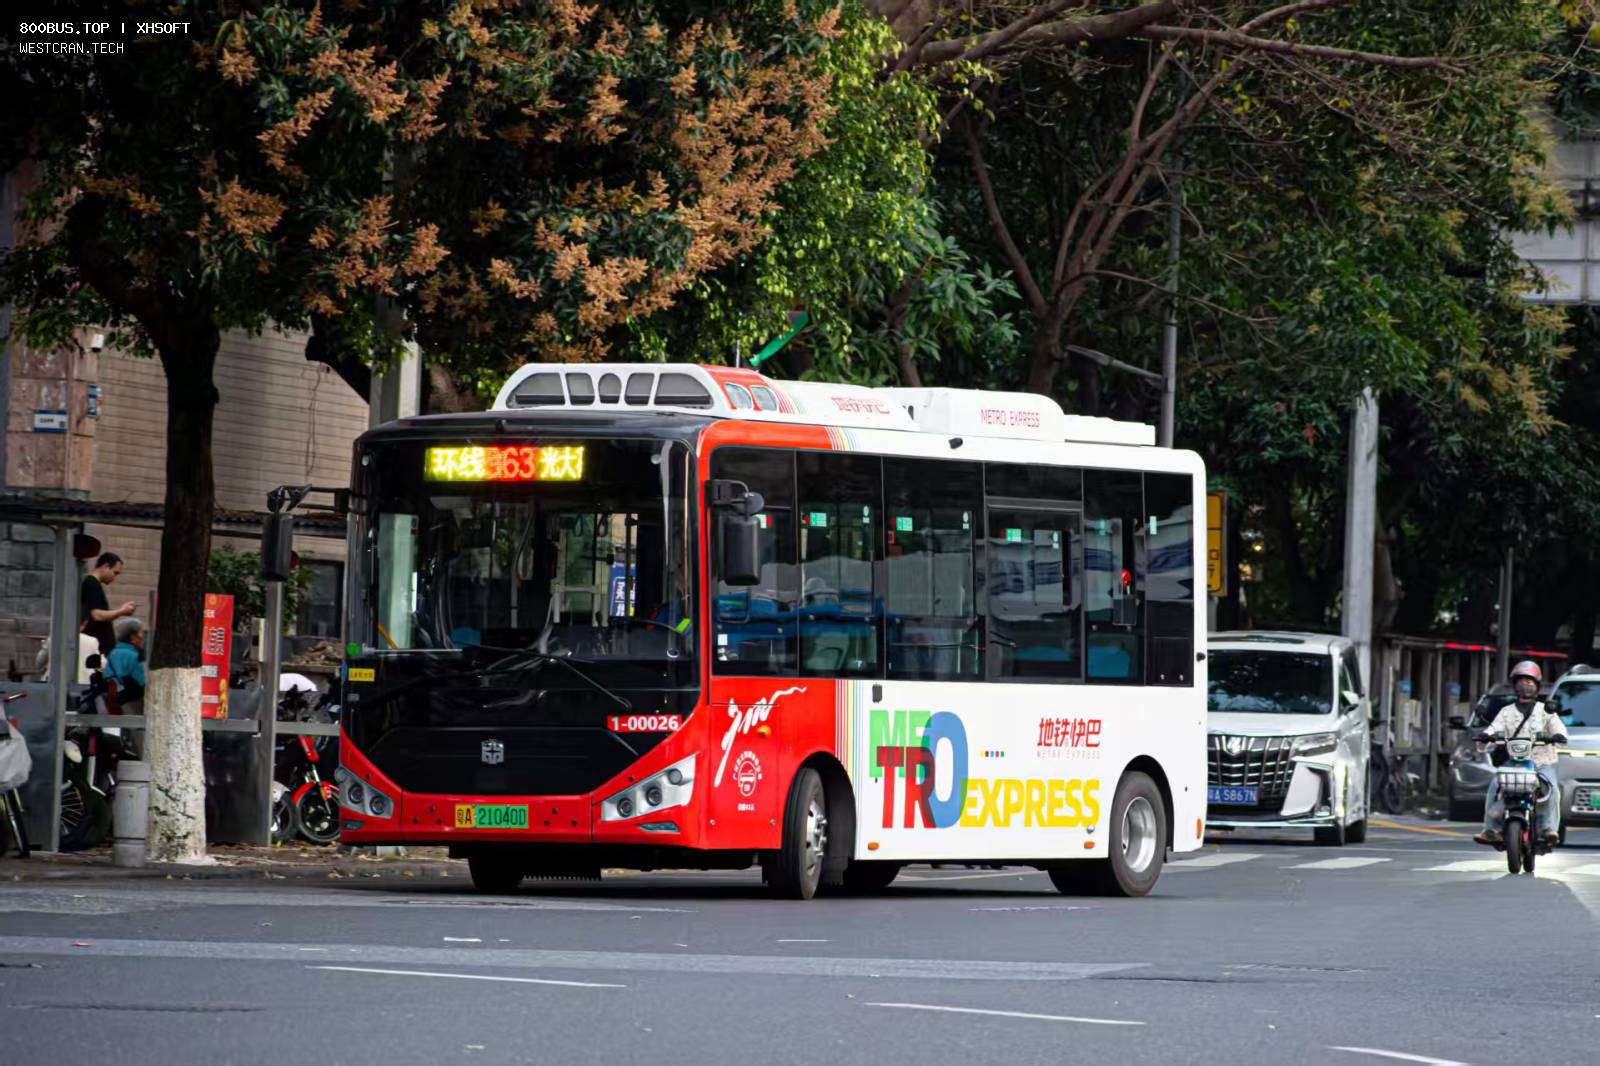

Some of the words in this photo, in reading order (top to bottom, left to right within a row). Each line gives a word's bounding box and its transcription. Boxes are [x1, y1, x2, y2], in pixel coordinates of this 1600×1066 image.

[980, 409, 1006, 425] METRO
[611, 715, 679, 731] 1-00026
[1037, 718, 1101, 747] 地铁快巴
[960, 778, 1100, 828] EXPRESS
